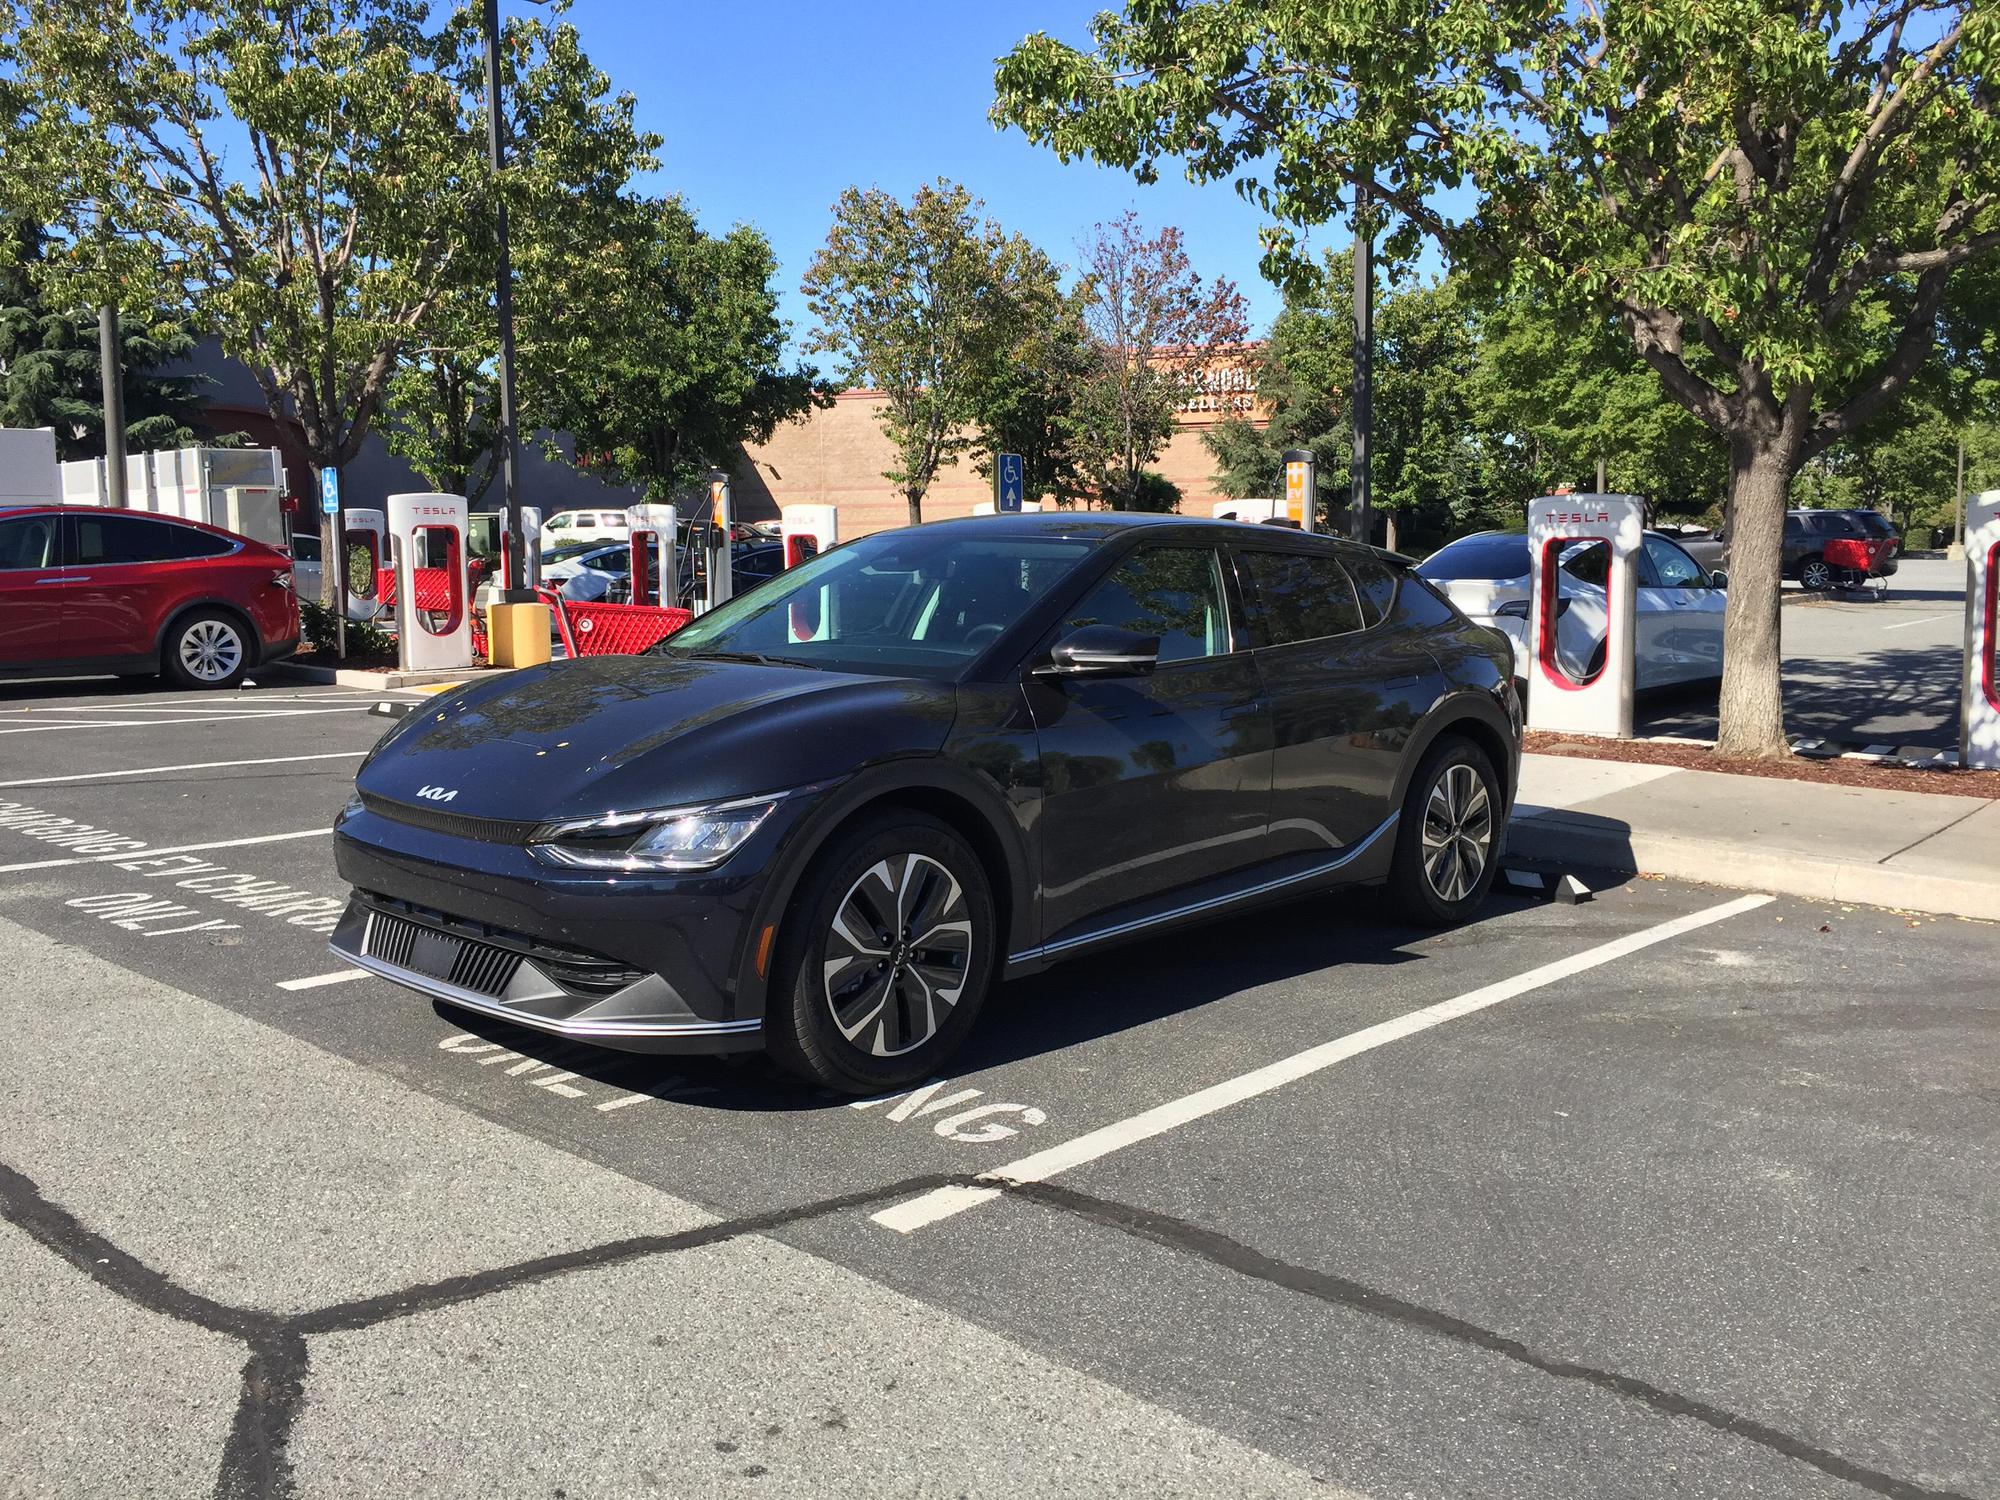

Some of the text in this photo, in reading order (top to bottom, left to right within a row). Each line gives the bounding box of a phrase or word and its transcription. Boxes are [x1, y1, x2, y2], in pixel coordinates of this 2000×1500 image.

[411, 507, 456, 515] TESLA
[1545, 512, 1609, 524] TESLA
[64, 892, 243, 937] ONLY
[175, 873, 347, 937] CHARG
